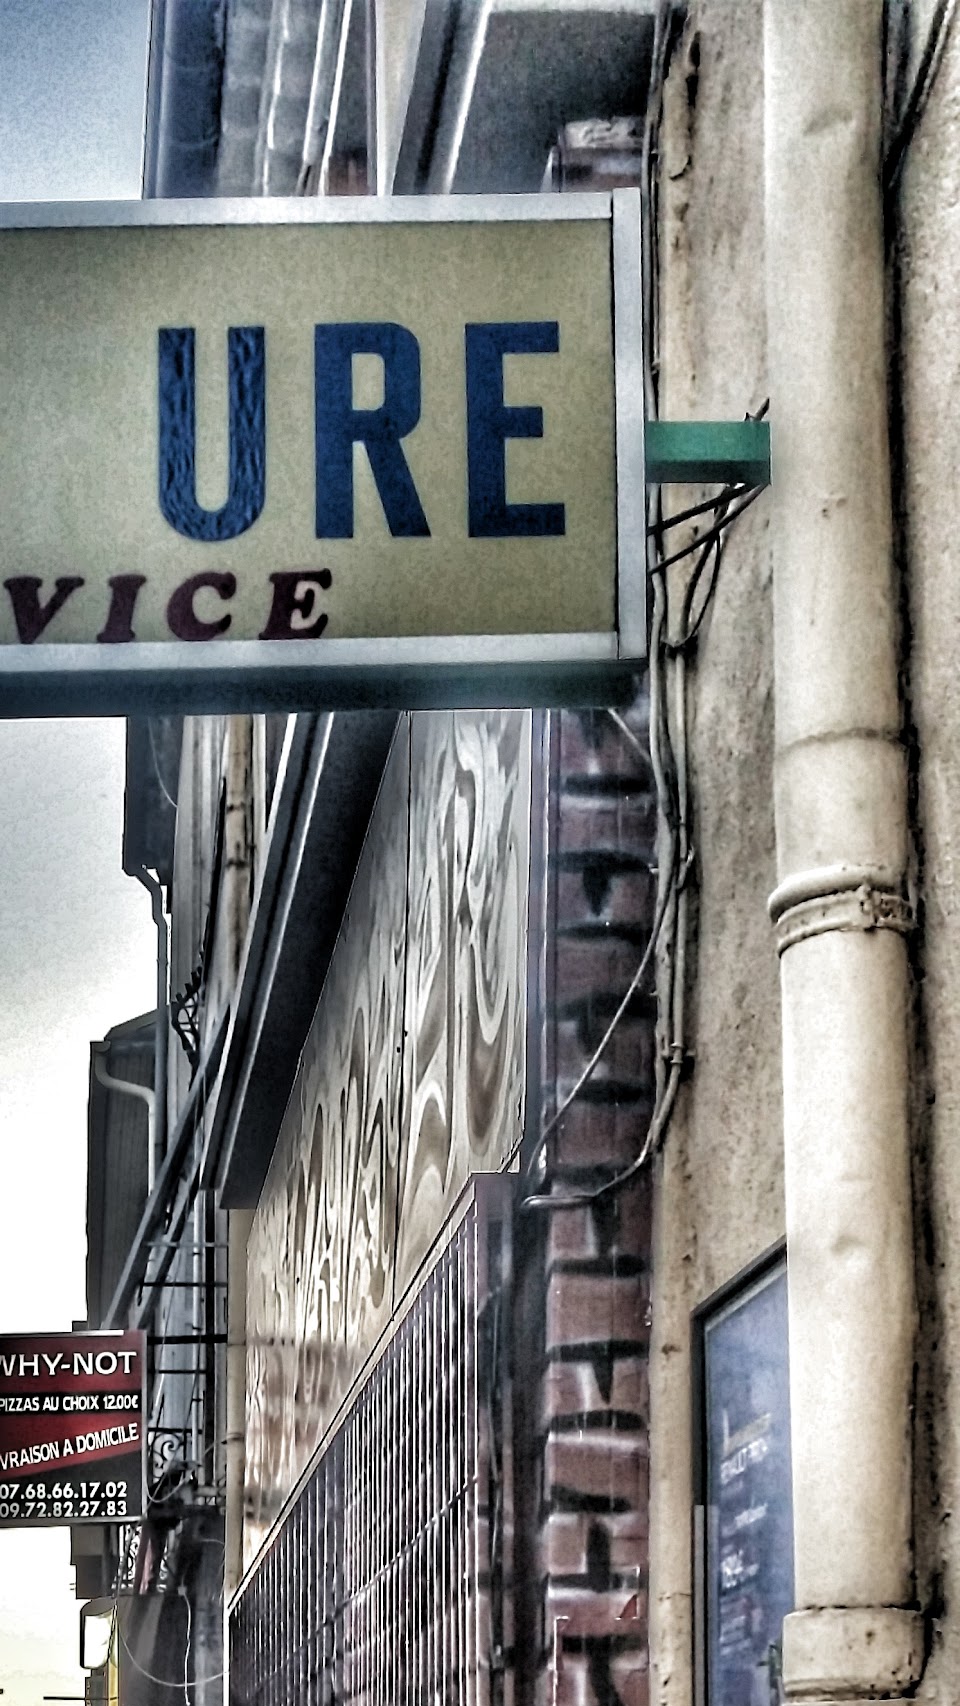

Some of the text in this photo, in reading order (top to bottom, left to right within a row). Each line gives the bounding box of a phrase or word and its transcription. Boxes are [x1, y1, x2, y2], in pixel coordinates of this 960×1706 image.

[42, 1396, 60, 1411] AU
[62, 1396, 100, 1411] CHOIX
[75, 1422, 140, 1453] DOMICILE
